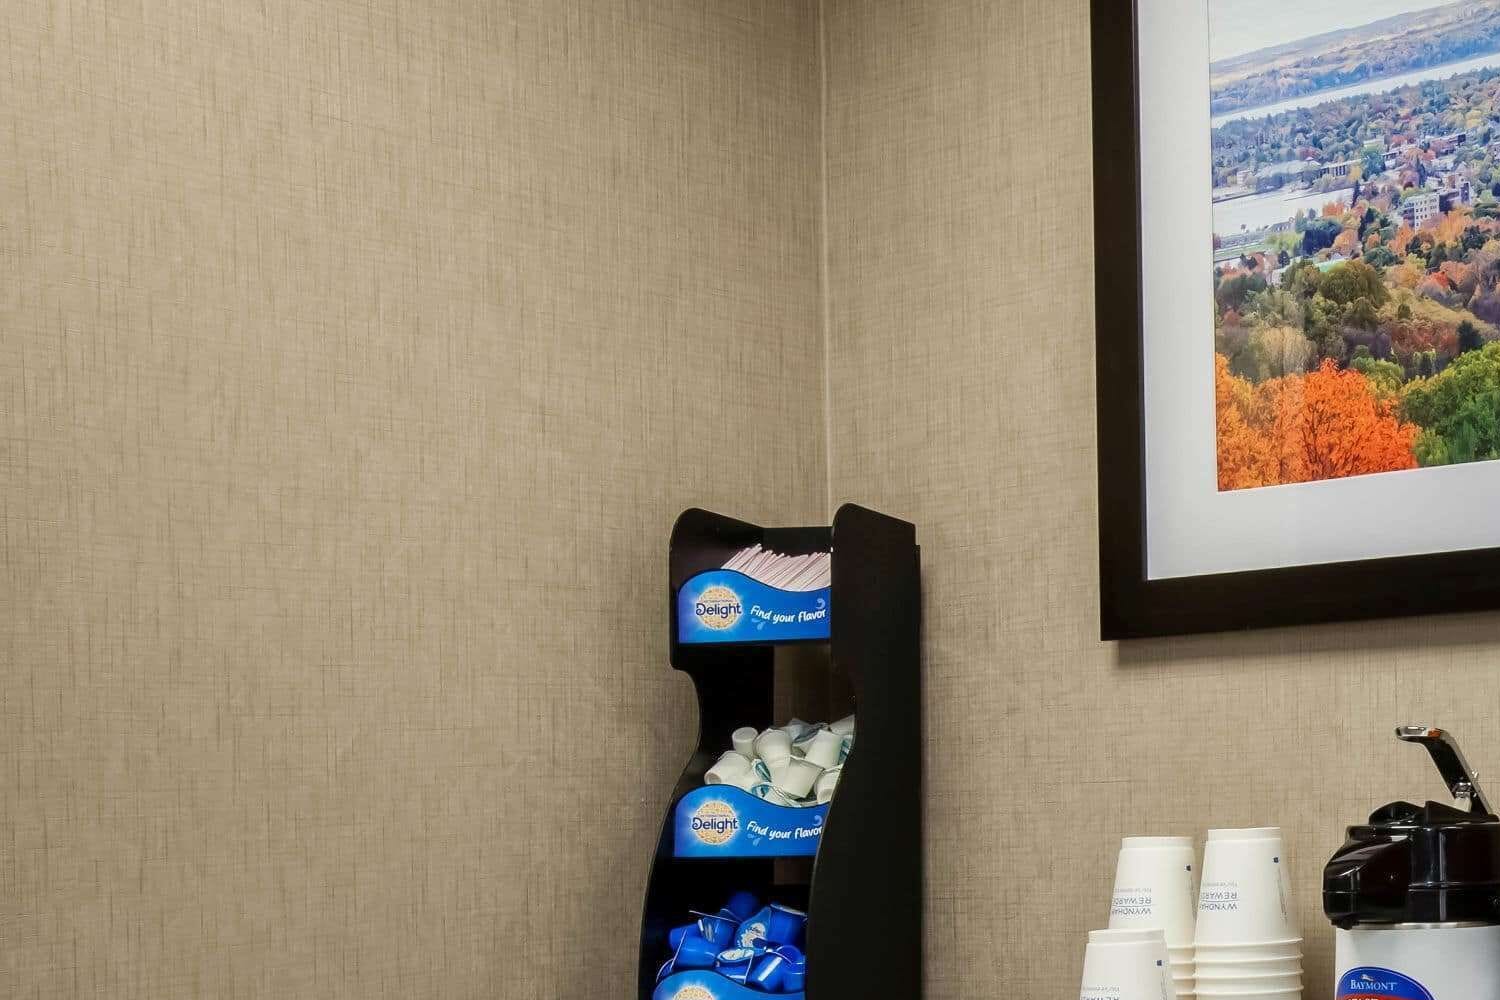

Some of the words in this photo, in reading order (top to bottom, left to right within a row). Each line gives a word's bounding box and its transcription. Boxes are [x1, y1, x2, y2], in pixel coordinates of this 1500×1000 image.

[696, 603, 742, 618] Delight
[750, 605, 770, 620] Find
[773, 613, 795, 624] your
[798, 609, 826, 622] flavor
[692, 817, 738, 833] Delight
[746, 821, 767, 836] Find
[769, 829, 791, 840] your
[794, 826, 823, 839] flavor
[1199, 903, 1238, 911] WYNDHA
[1350, 979, 1398, 991] BAYMONT
